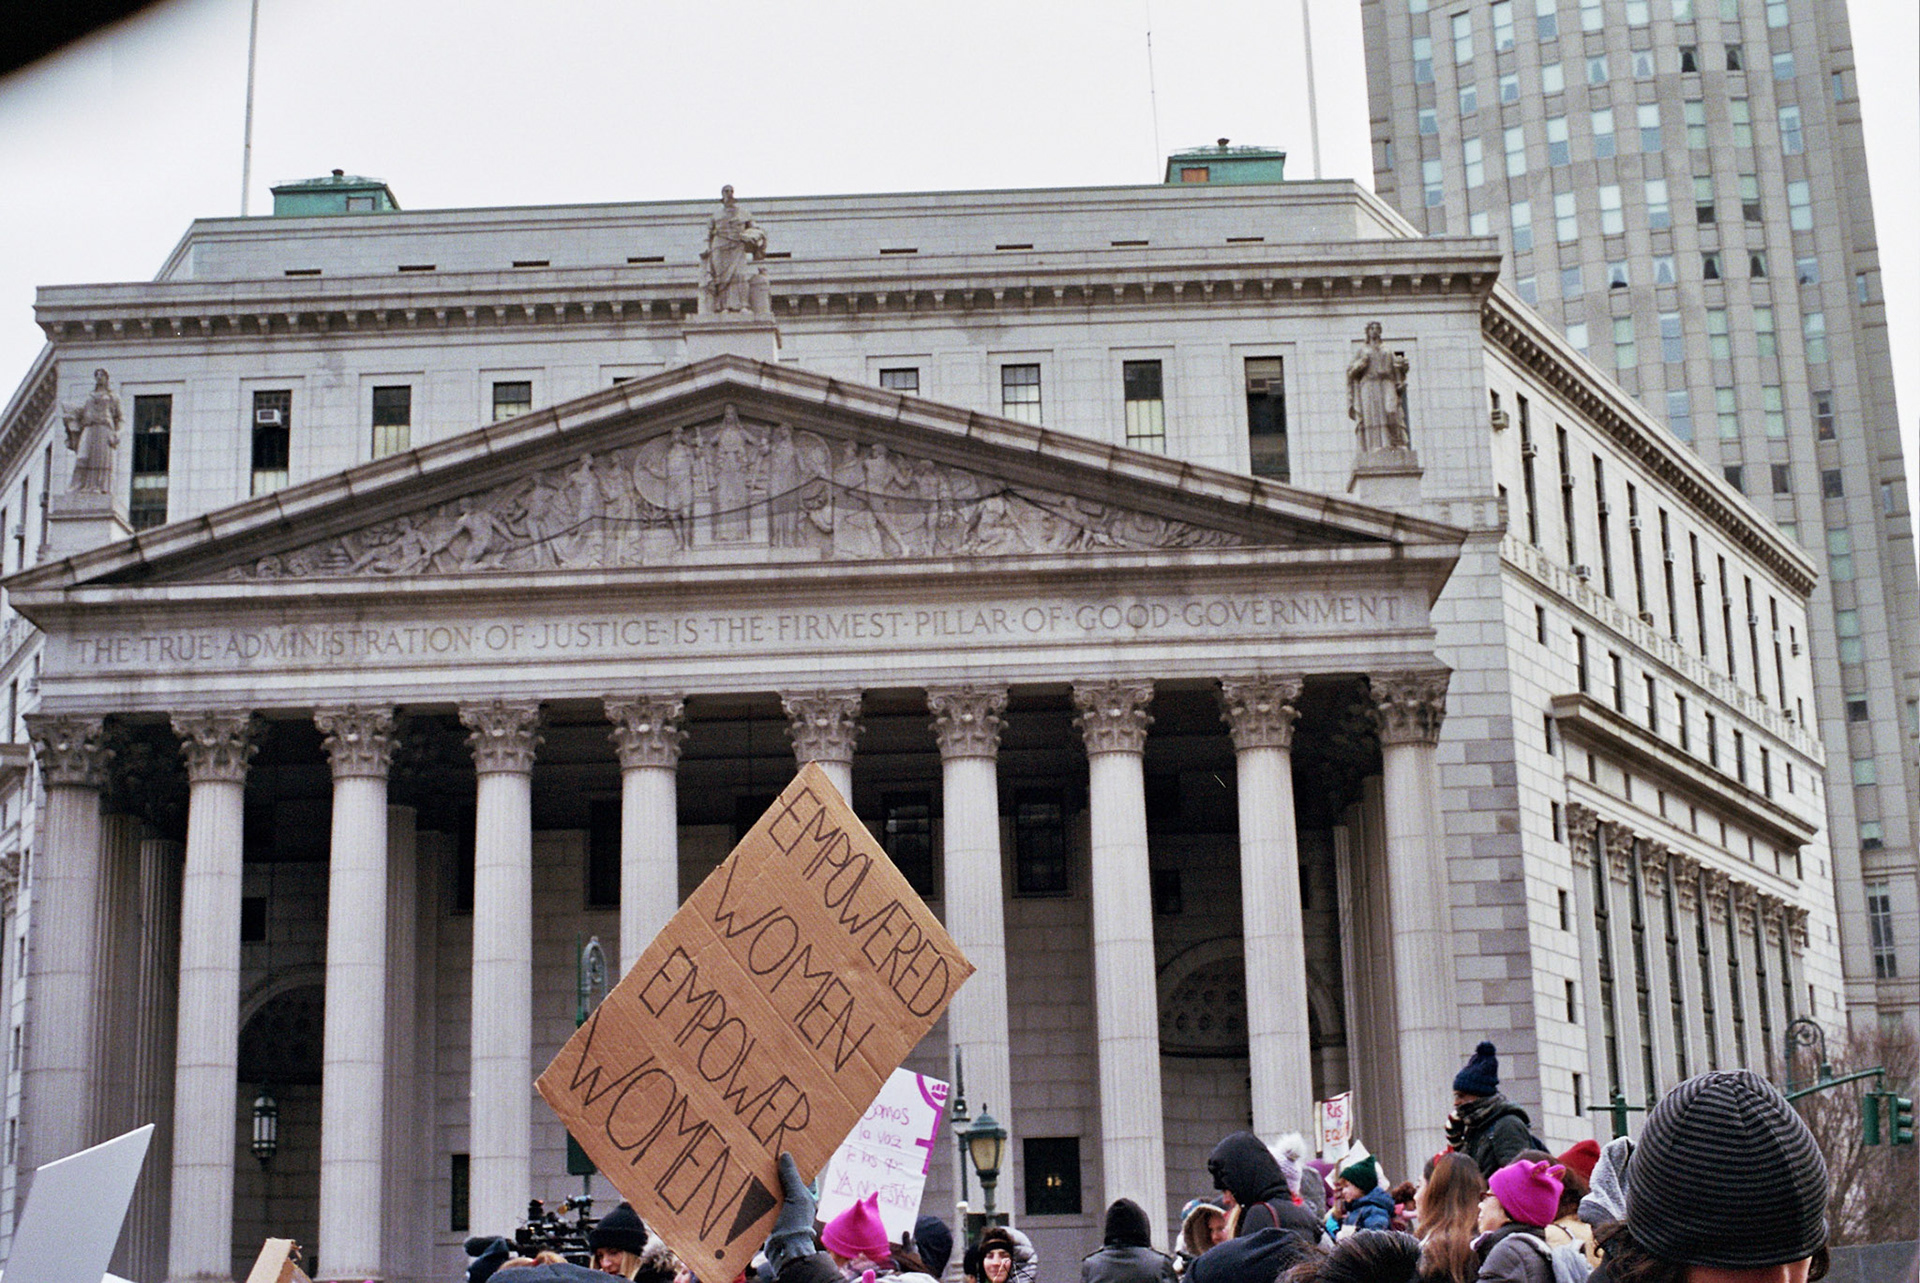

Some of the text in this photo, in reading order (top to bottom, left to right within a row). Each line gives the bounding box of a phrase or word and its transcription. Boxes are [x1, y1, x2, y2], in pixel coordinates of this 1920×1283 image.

[76, 595, 1401, 664] THE TRUE ADMINISTRATION OF JUSTICE IS THE FIRMEST PILLAR OF GOOD GOVERNMENT
[715, 855, 875, 1073] WOMEN
[768, 787, 950, 1018] EMPOWERED
[569, 1007, 778, 1260] WOMEN!
[639, 946, 810, 1161] EMPOWER
